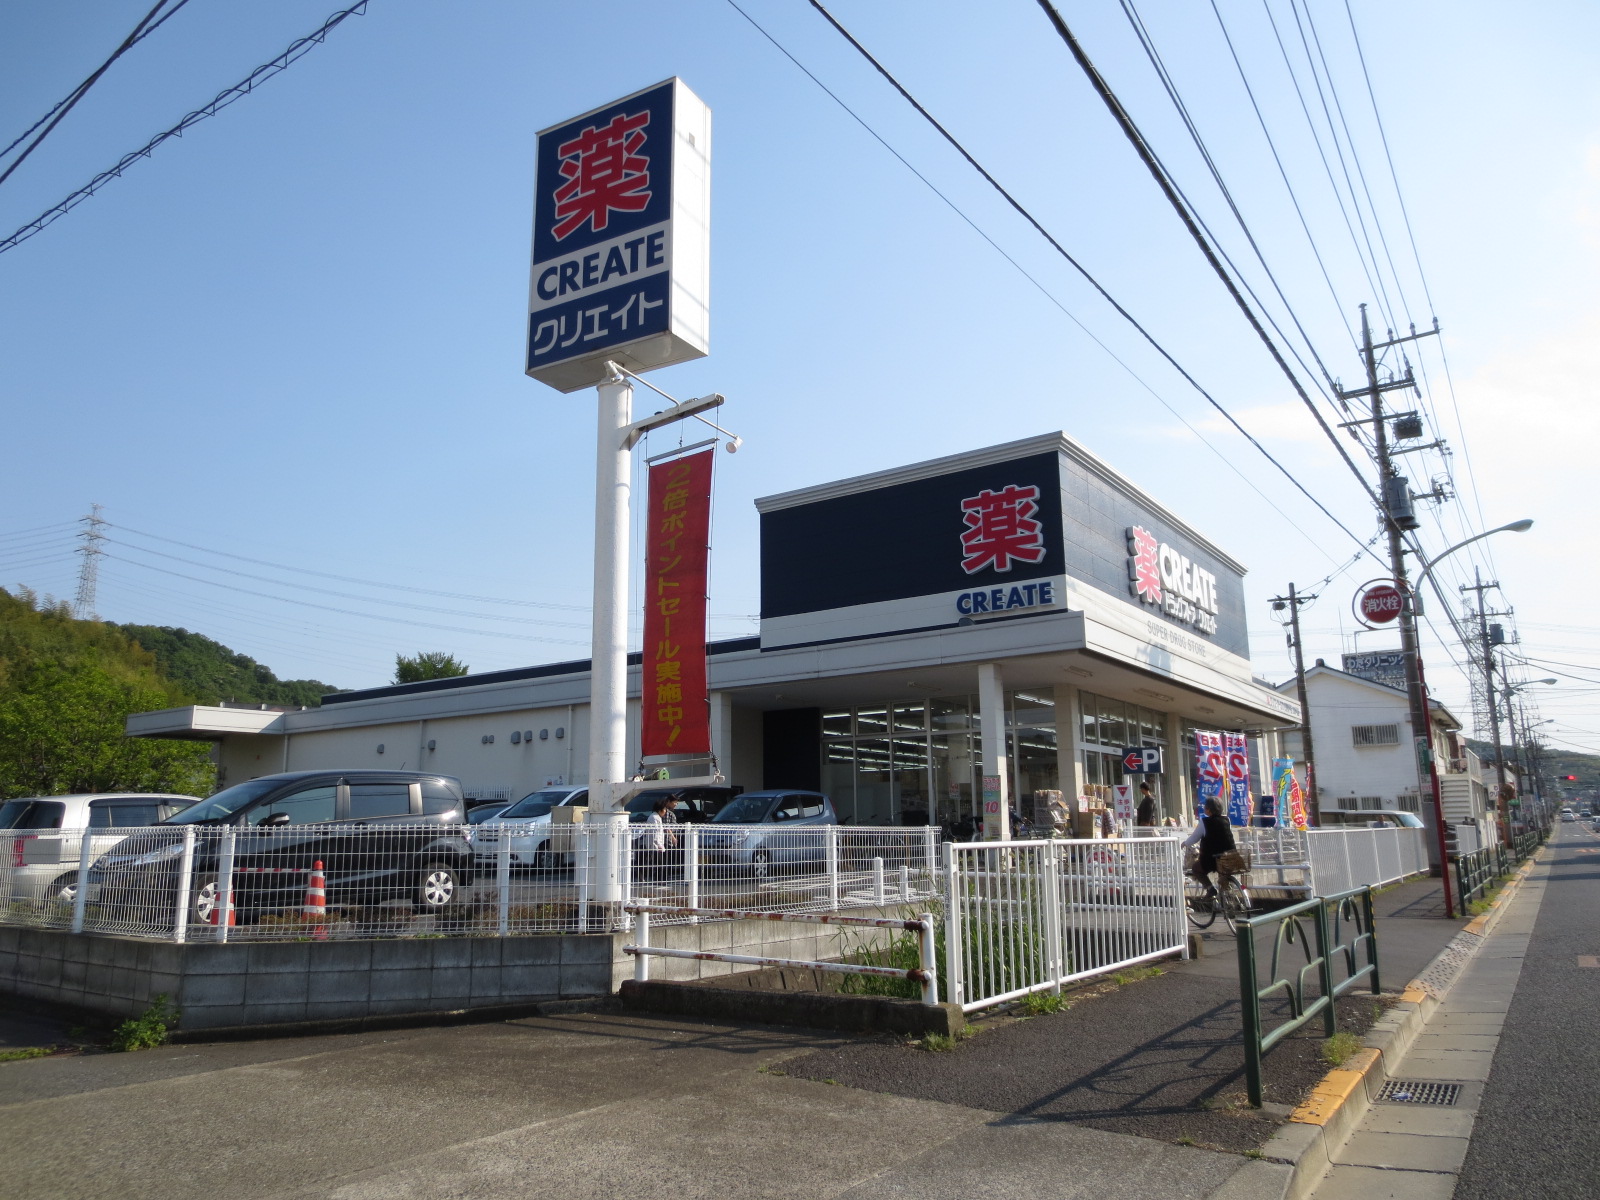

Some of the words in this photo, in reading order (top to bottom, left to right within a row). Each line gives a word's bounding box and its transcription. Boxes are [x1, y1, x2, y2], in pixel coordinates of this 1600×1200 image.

[551, 110, 652, 242] 薬
[537, 230, 664, 301] CREATE
[534, 291, 663, 356] クリエイト
[960, 484, 1046, 574] 薬
[956, 582, 1055, 615] CREATE
[1131, 525, 1162, 605] 薬
[1160, 543, 1218, 615] CREATE
[1365, 595, 1400, 613] 消火栓
[1147, 620, 1168, 642] SUPER
[1170, 631, 1187, 650] DRUG
[1188, 639, 1206, 658] STORE
[1142, 749, 1159, 772] P
